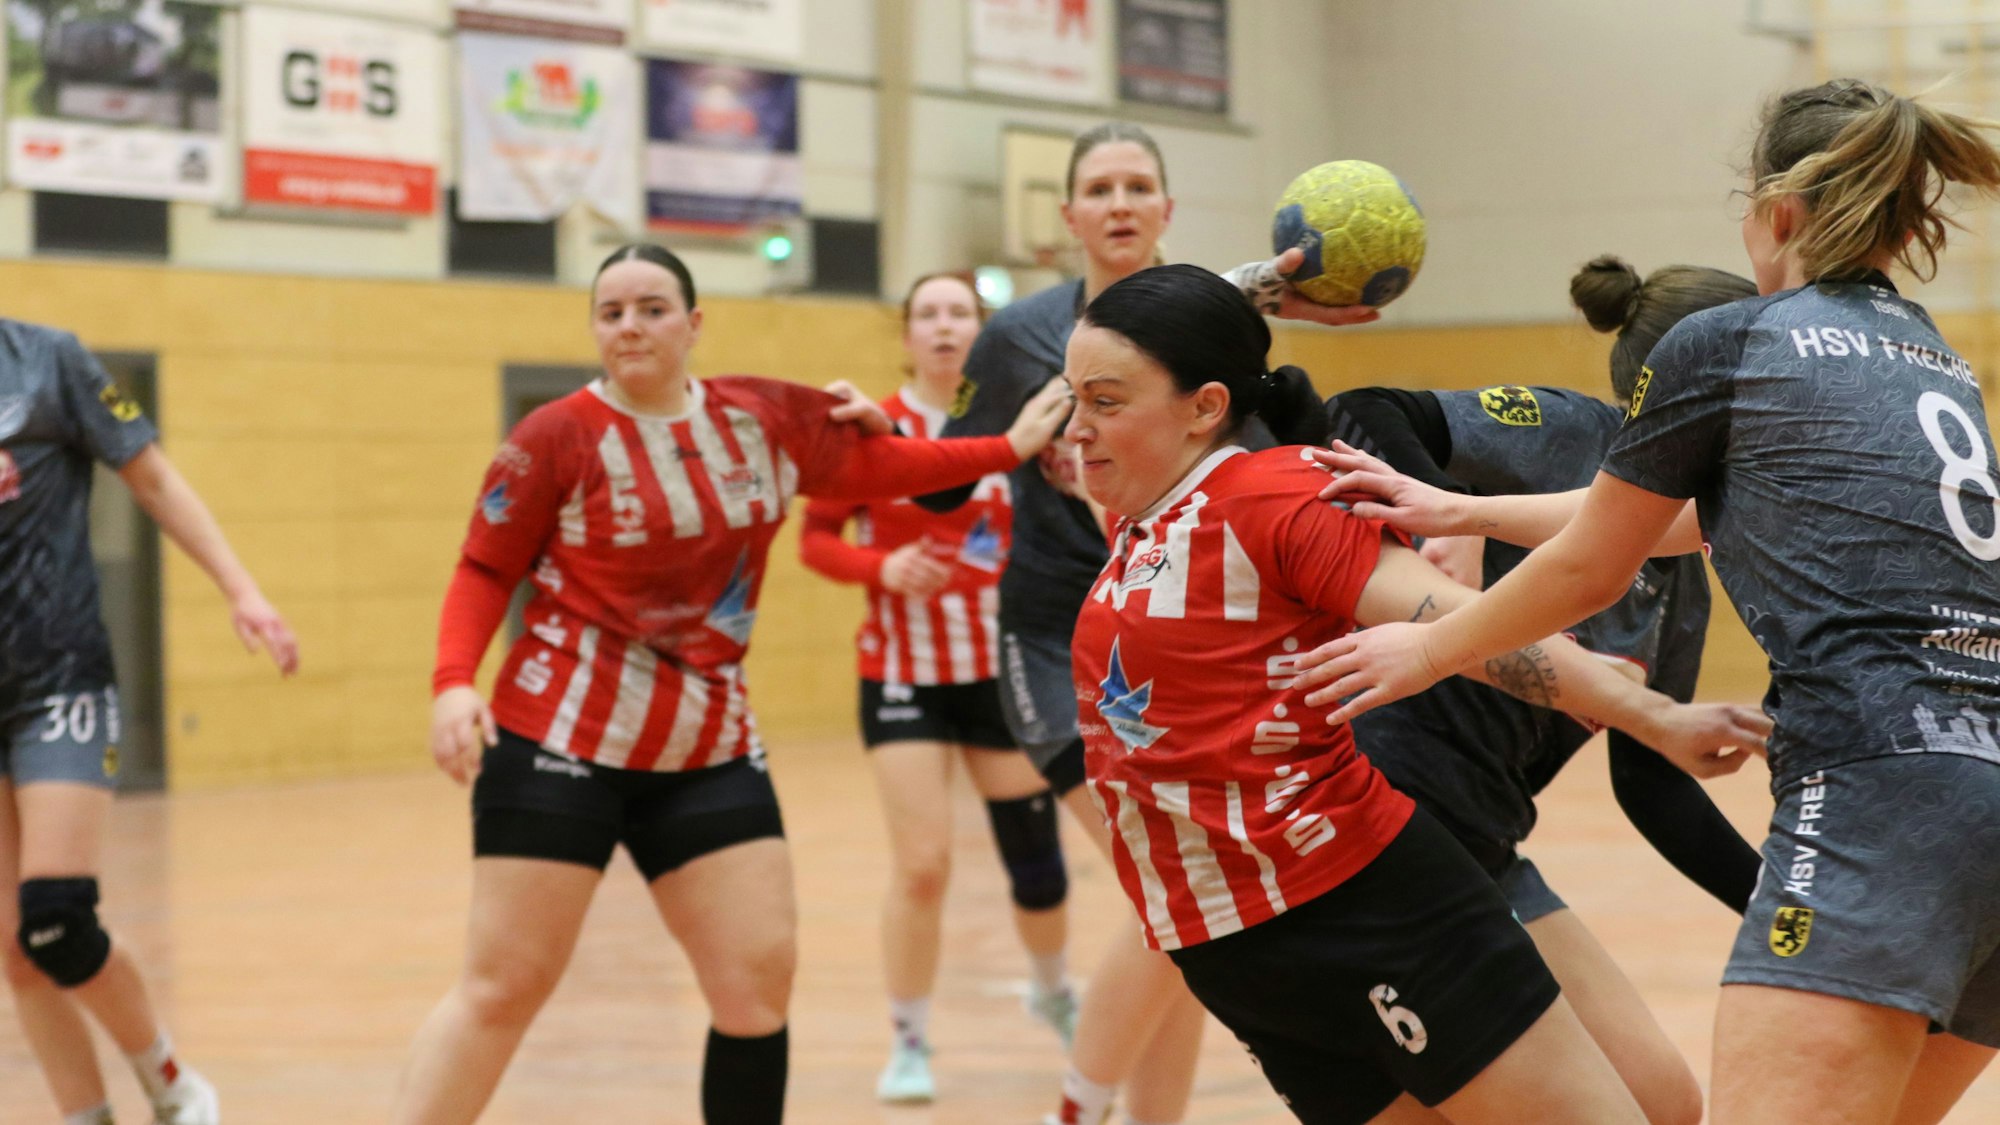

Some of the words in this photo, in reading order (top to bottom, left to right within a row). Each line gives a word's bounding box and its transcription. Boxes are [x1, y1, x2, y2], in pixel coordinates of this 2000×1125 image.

[1790, 327, 1870, 358] HSV
[1916, 391, 2000, 562] 8
[41, 693, 97, 743] 30
[1368, 983, 1428, 1054] 6
